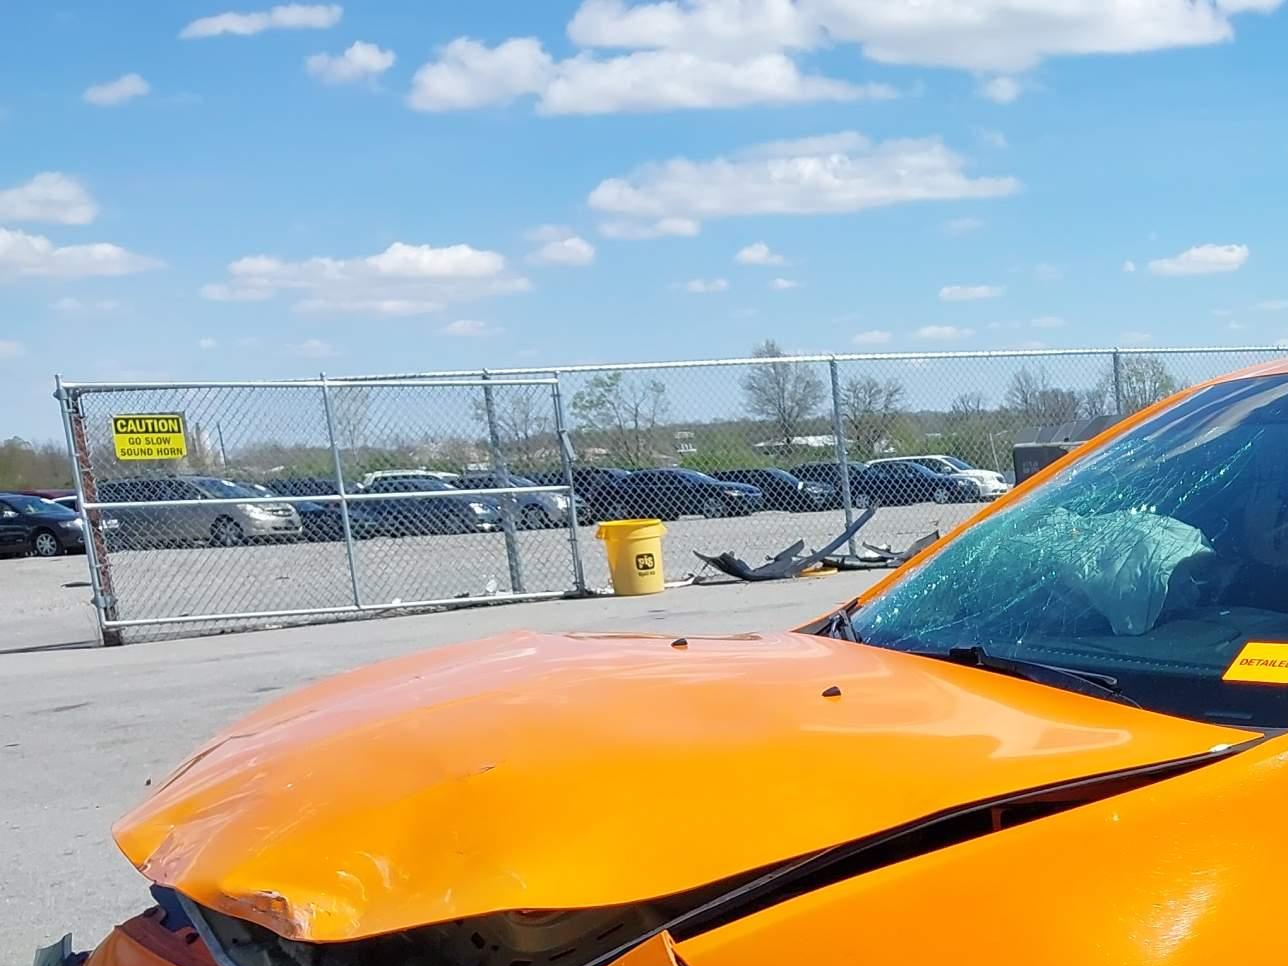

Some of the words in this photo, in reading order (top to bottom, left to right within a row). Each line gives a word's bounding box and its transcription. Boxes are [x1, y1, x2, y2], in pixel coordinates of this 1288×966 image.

[116, 419, 179, 432] CAUTION
[128, 437, 141, 445] GO
[145, 437, 171, 445] SLOW
[120, 447, 153, 456] SOUND
[157, 447, 183, 456] HORN
